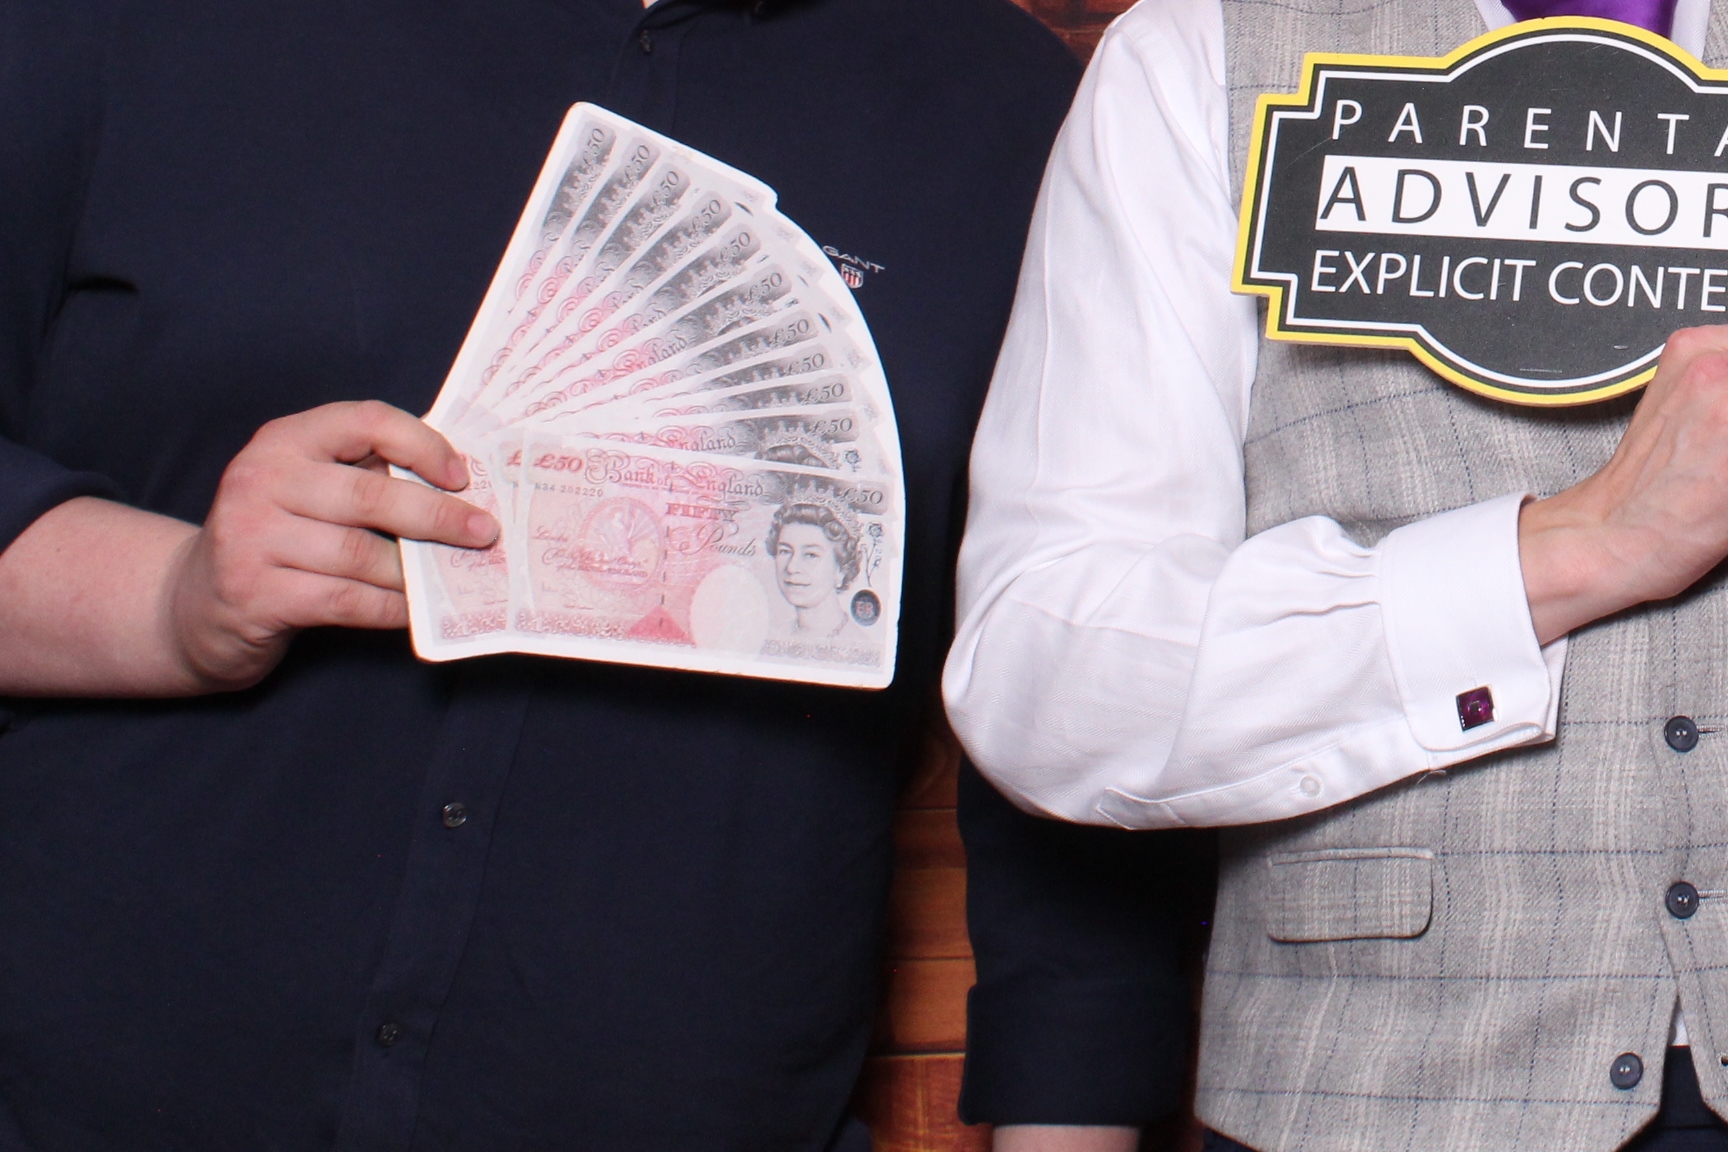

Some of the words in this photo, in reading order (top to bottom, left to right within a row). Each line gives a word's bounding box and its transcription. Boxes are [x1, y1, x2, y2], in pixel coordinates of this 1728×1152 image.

[692, 199, 721, 233] £50
[720, 232, 751, 262] £50
[822, 245, 885, 274] GANT
[748, 272, 782, 301] £50
[1310, 250, 1538, 303] EXPLICIT
[772, 318, 810, 343] £50
[785, 353, 825, 376] £50
[804, 383, 845, 403] £50
[810, 418, 853, 434] £50
[533, 452, 584, 473] £50
[585, 448, 656, 485] Bank
[685, 460, 766, 500] England
[840, 488, 884, 505] £50
[665, 502, 740, 522] FIFTY
[669, 522, 757, 557] Pounds
